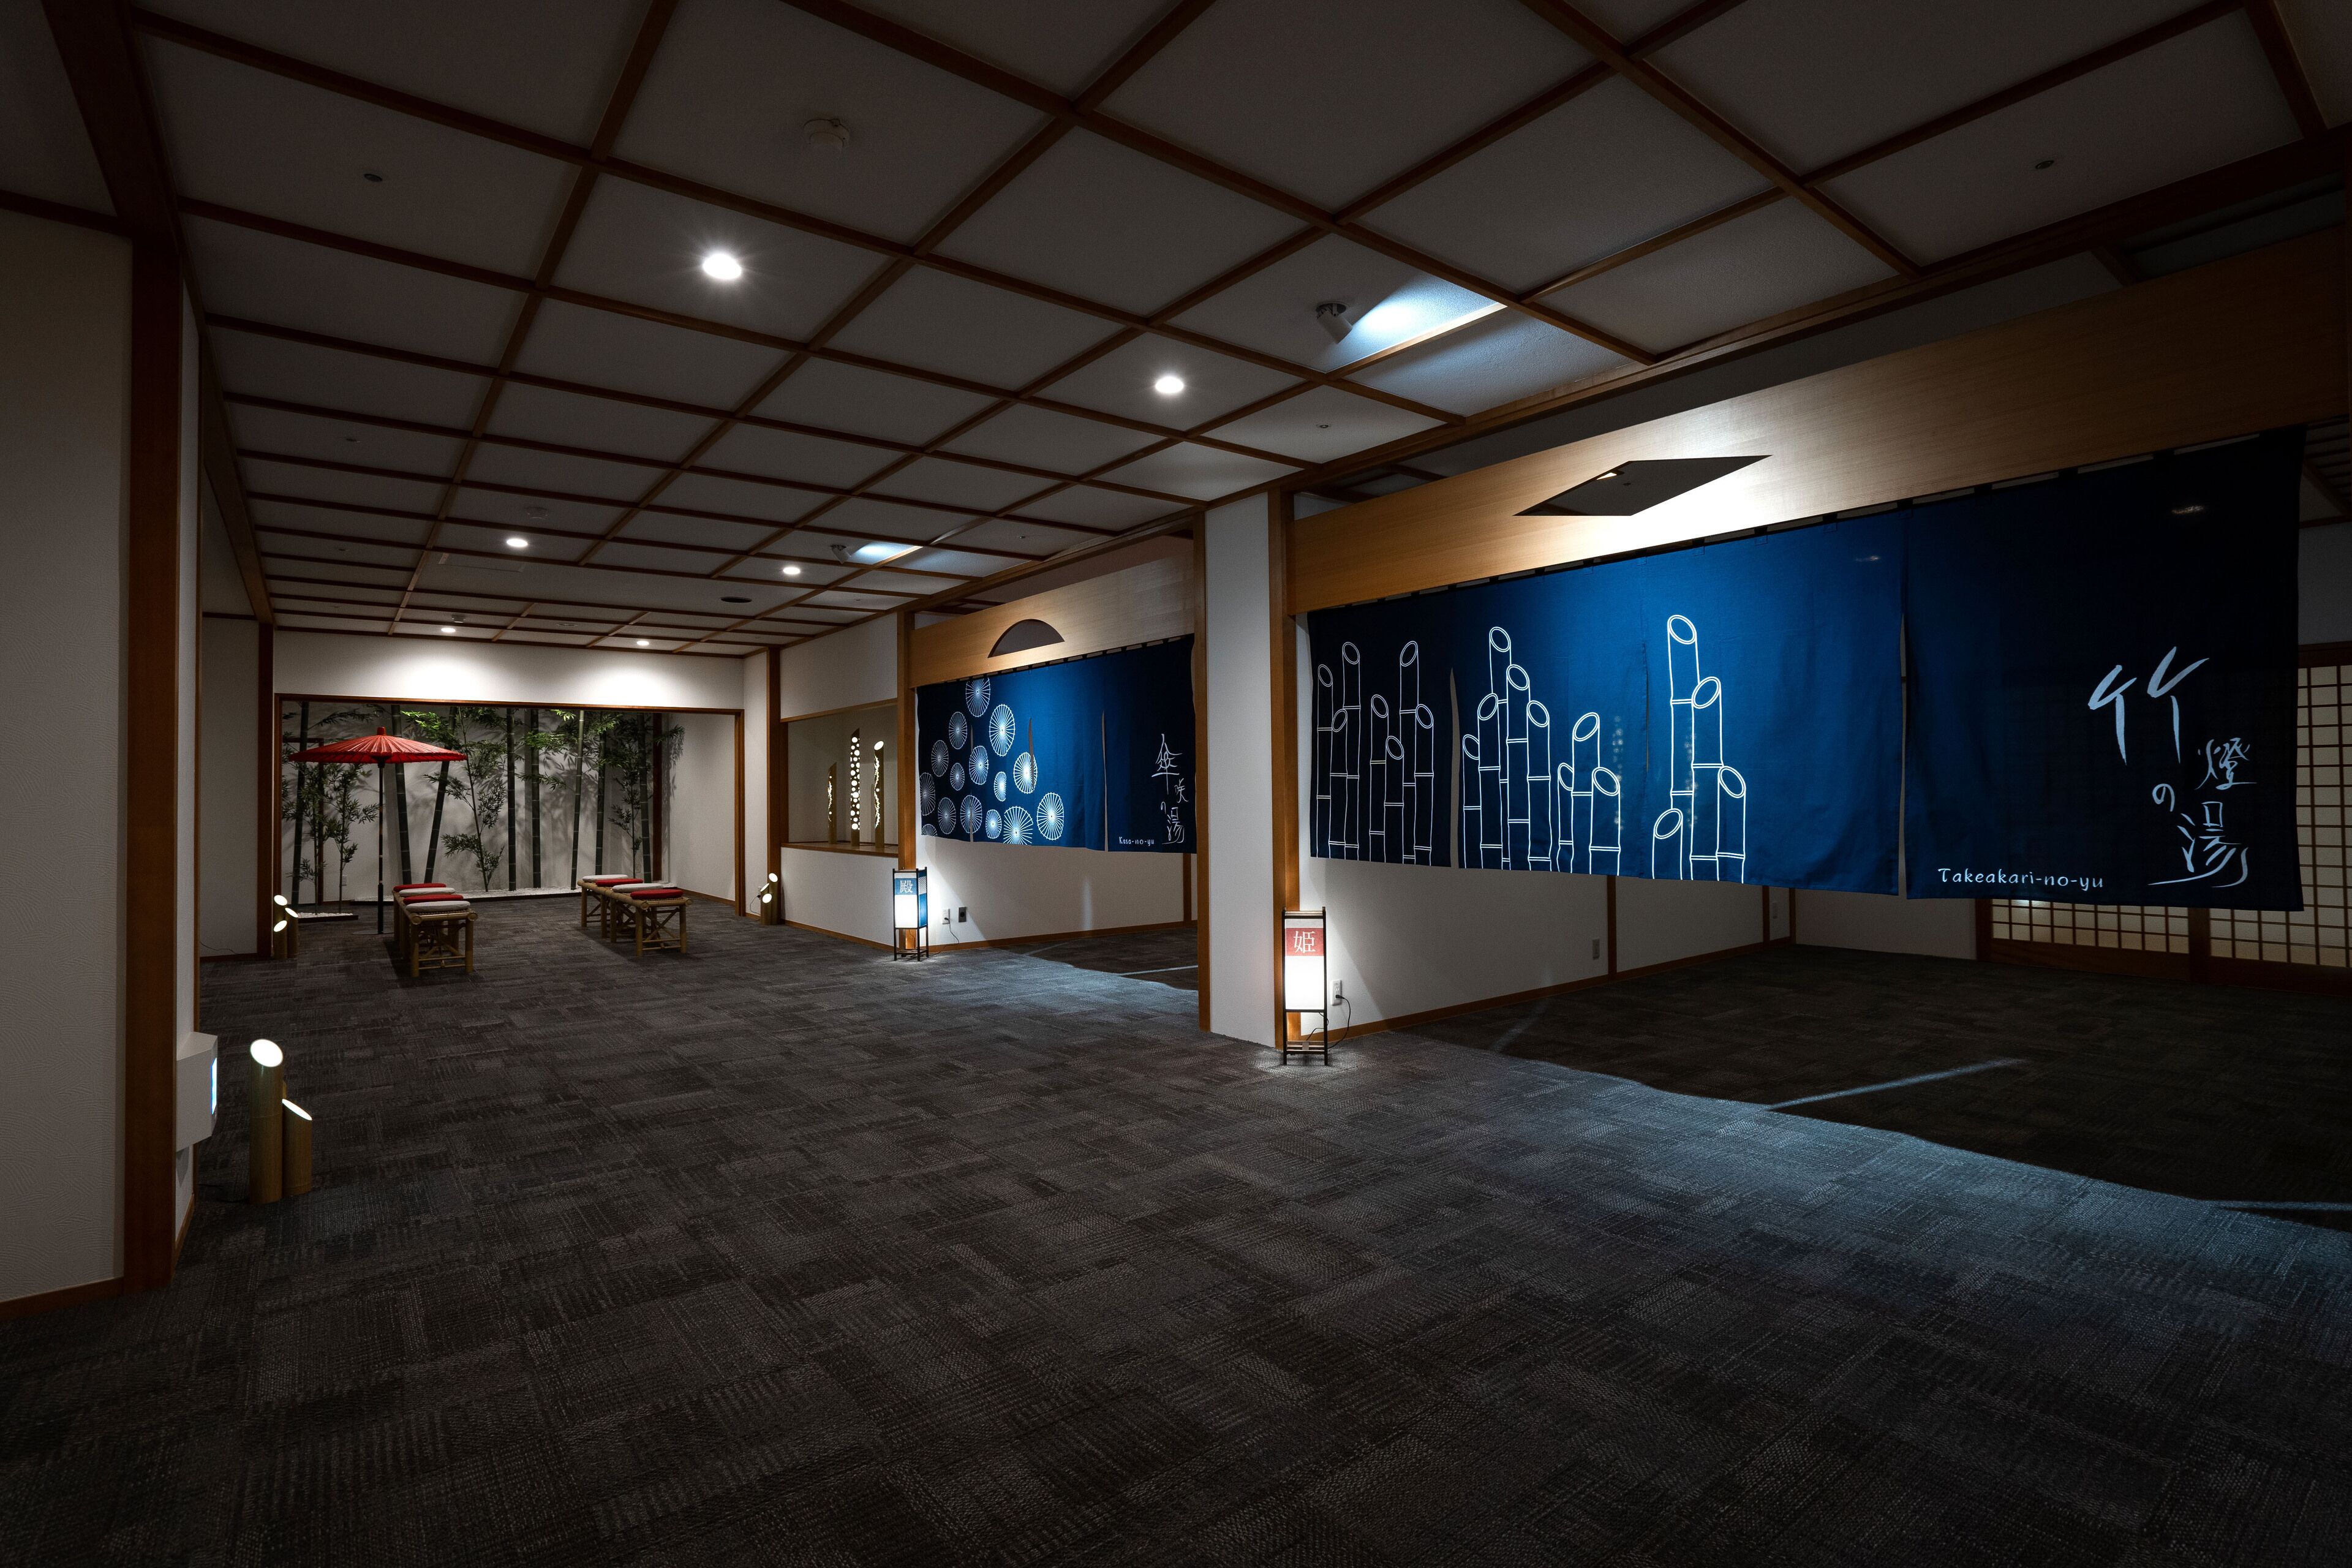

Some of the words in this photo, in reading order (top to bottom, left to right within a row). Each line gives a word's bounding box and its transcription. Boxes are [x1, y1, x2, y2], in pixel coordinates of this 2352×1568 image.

[1118, 836, 1155, 846] Kasa-no-yu
[900, 880, 913, 893] 殿
[1937, 867, 2103, 891] Takeakari-no-yu
[1293, 930, 1316, 954] 姫
